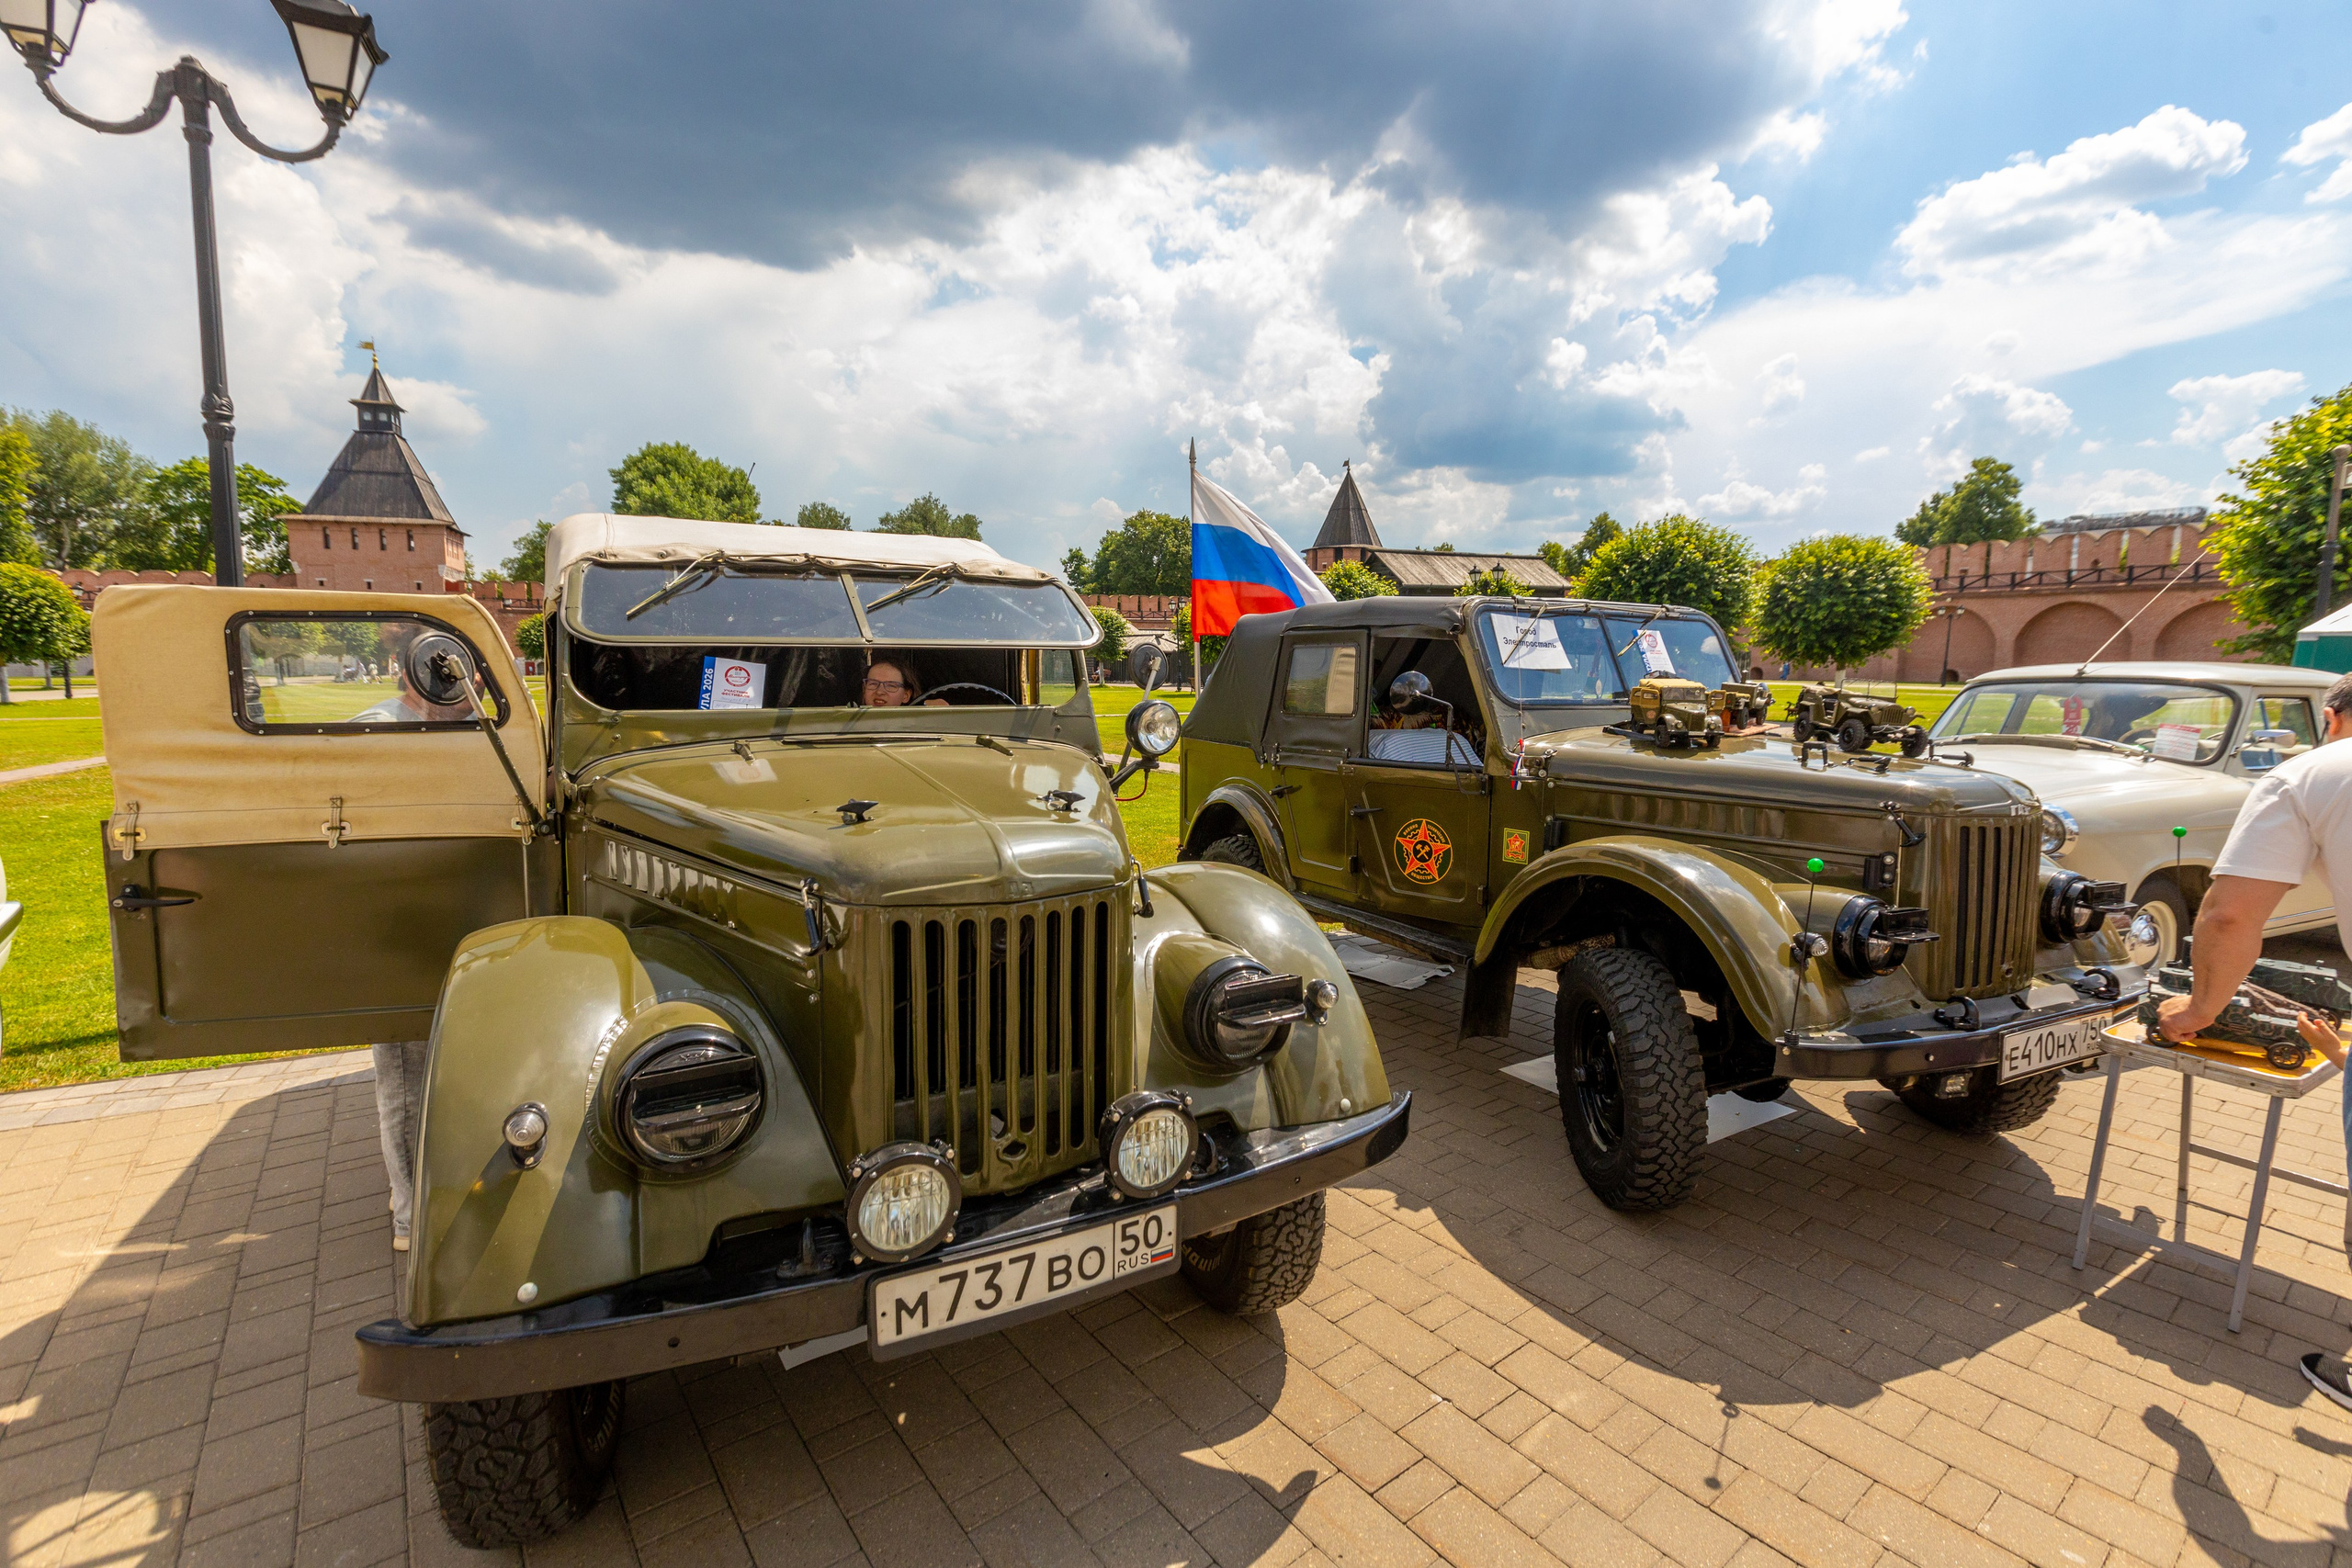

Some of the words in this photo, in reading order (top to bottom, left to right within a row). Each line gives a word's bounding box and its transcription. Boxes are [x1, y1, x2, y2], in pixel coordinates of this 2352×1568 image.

[1515, 626, 1537, 636] Гоод
[1502, 637, 1557, 649] Элетросталь
[703, 668, 714, 691] 2026
[1120, 1214, 1163, 1257] 50
[1117, 1252, 1149, 1272] RUS
